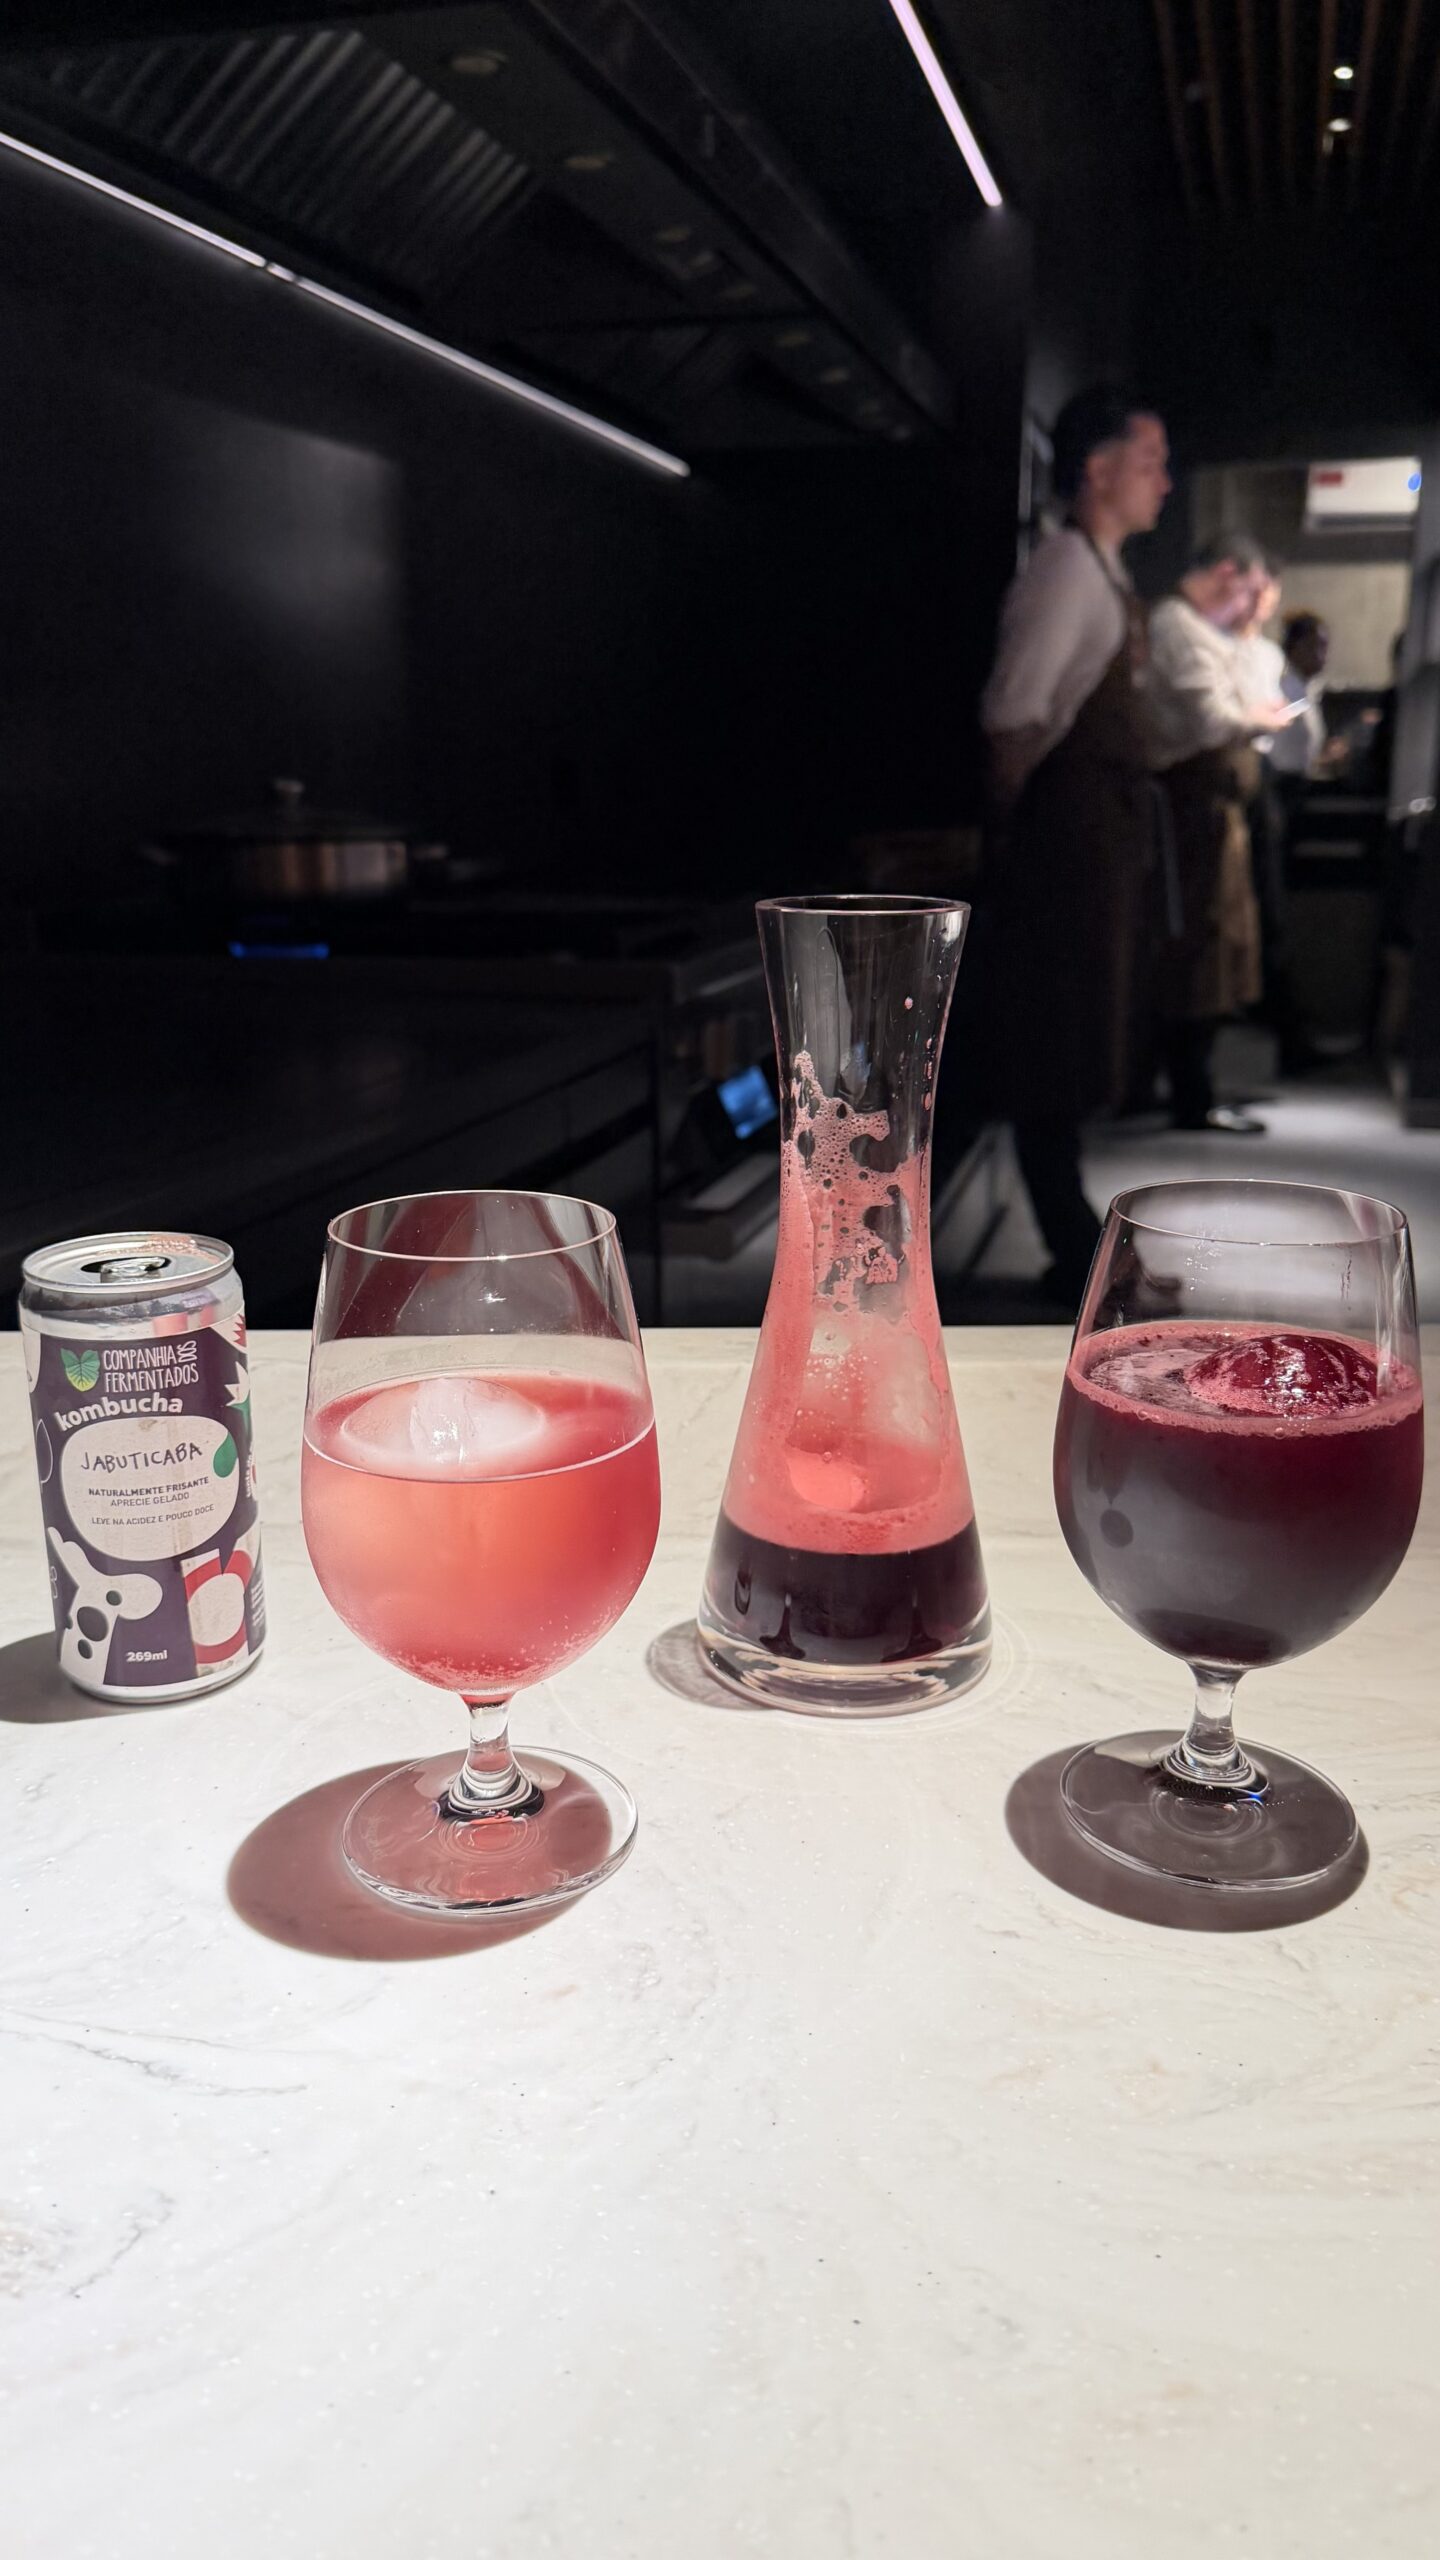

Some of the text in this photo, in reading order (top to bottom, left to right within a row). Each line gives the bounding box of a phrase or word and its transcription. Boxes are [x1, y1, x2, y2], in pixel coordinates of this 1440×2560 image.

[103, 1340, 197, 1371] COMPANHIA DOS
[104, 1363, 199, 1393] FERMENTADOS
[54, 1392, 183, 1432] kombucha
[81, 1442, 202, 1473] JABUTICABA
[88, 1476, 209, 1497] NATURALMENTE FRISANTE
[110, 1491, 190, 1507] APRECIE GELADO
[91, 1517, 111, 1525] LEVE
[126, 1516, 156, 1525] ACIDEZ
[158, 1515, 164, 1523] E
[165, 1509, 193, 1522] POUCO
[194, 1503, 215, 1516] DOCE
[126, 1649, 168, 1662] 269ml
